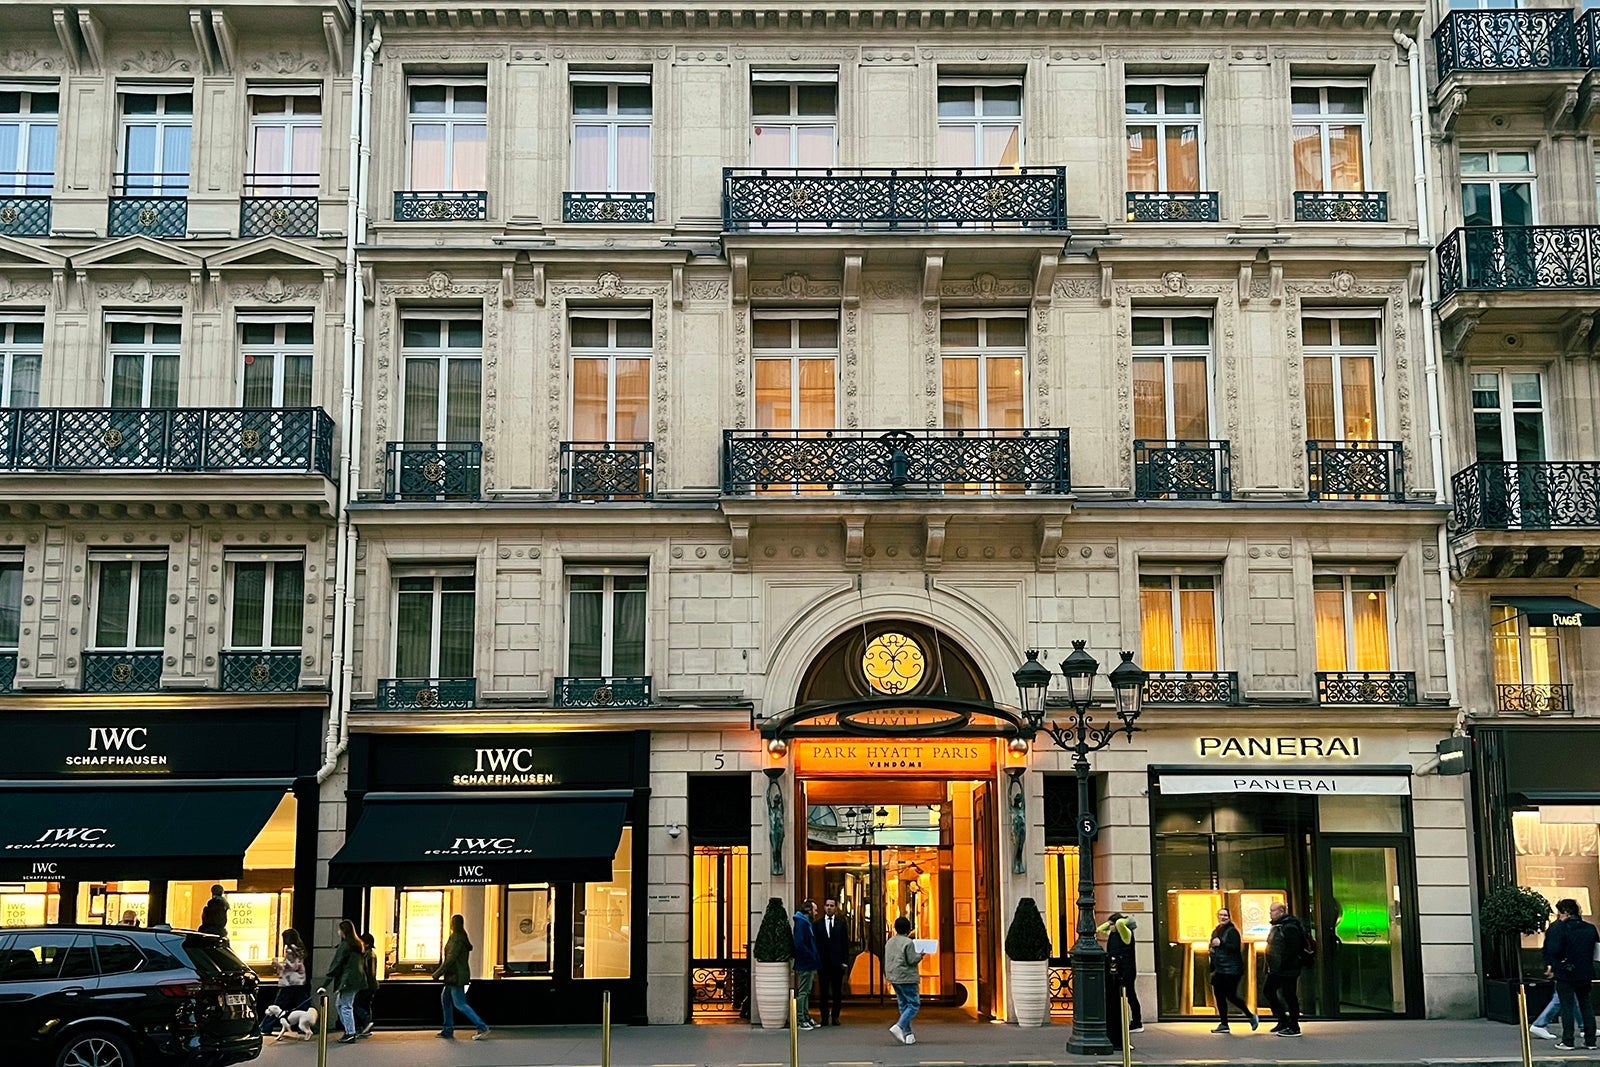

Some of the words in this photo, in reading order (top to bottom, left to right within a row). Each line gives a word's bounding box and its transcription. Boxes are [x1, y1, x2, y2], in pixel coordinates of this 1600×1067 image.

[1552, 613, 1582, 627] PIAGET
[88, 728, 147, 750] IWC
[1200, 737, 1360, 756] PANERAI
[813, 747, 857, 758] PARK
[867, 747, 923, 758] HYATT
[933, 747, 978, 758] PARIS
[66, 756, 167, 765] SCHAFFHAUSEN
[474, 748, 533, 772] IWC
[714, 754, 724, 770] 5
[869, 760, 922, 768] VENDÔME
[452, 774, 553, 784] SCHAFFHAUSEN
[1233, 779, 1337, 791] PANERAI
[1084, 820, 1091, 832] 5
[36, 828, 107, 842] IWC
[450, 838, 515, 849] IWC
[32, 863, 57, 873] IWC
[459, 866, 484, 876] IWC
[7, 910, 26, 918] TOP
[233, 909, 252, 917] TOP
[232, 917, 252, 925] GUN
